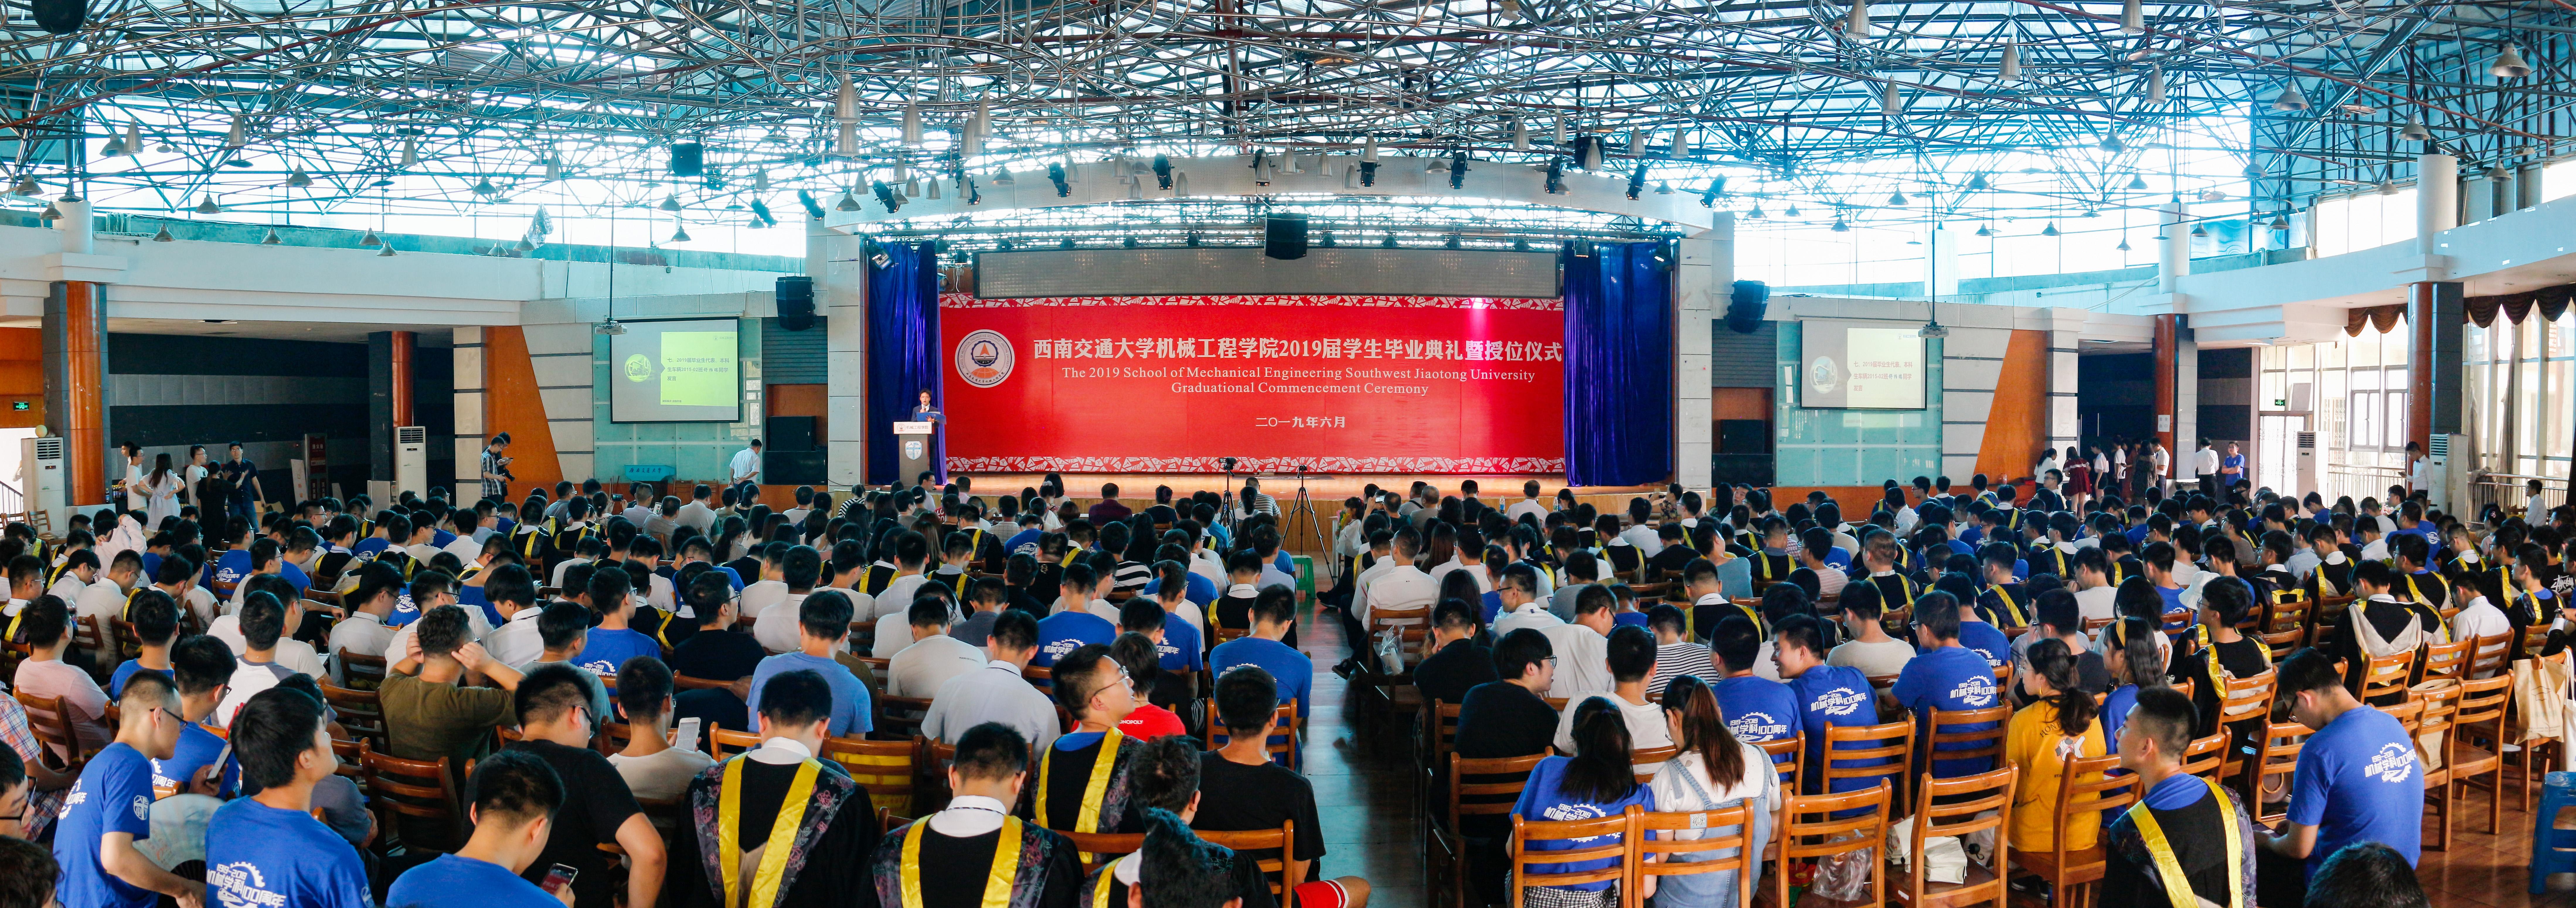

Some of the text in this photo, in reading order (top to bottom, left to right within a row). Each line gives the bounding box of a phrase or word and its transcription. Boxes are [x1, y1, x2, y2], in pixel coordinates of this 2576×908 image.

[1033, 337, 1562, 362] 西南交通大学机械工程学院2019届学生毕业典礼暨授位仪式
[1062, 367, 1534, 382] The 2019 School of Mechanical Engineering Southwest Jiaotong University
[1172, 382, 1429, 396] Graduational Commencement Ceremony
[1811, 692, 1867, 712] 机械学科100周年
[206, 869, 287, 908] 机械学科100周年
